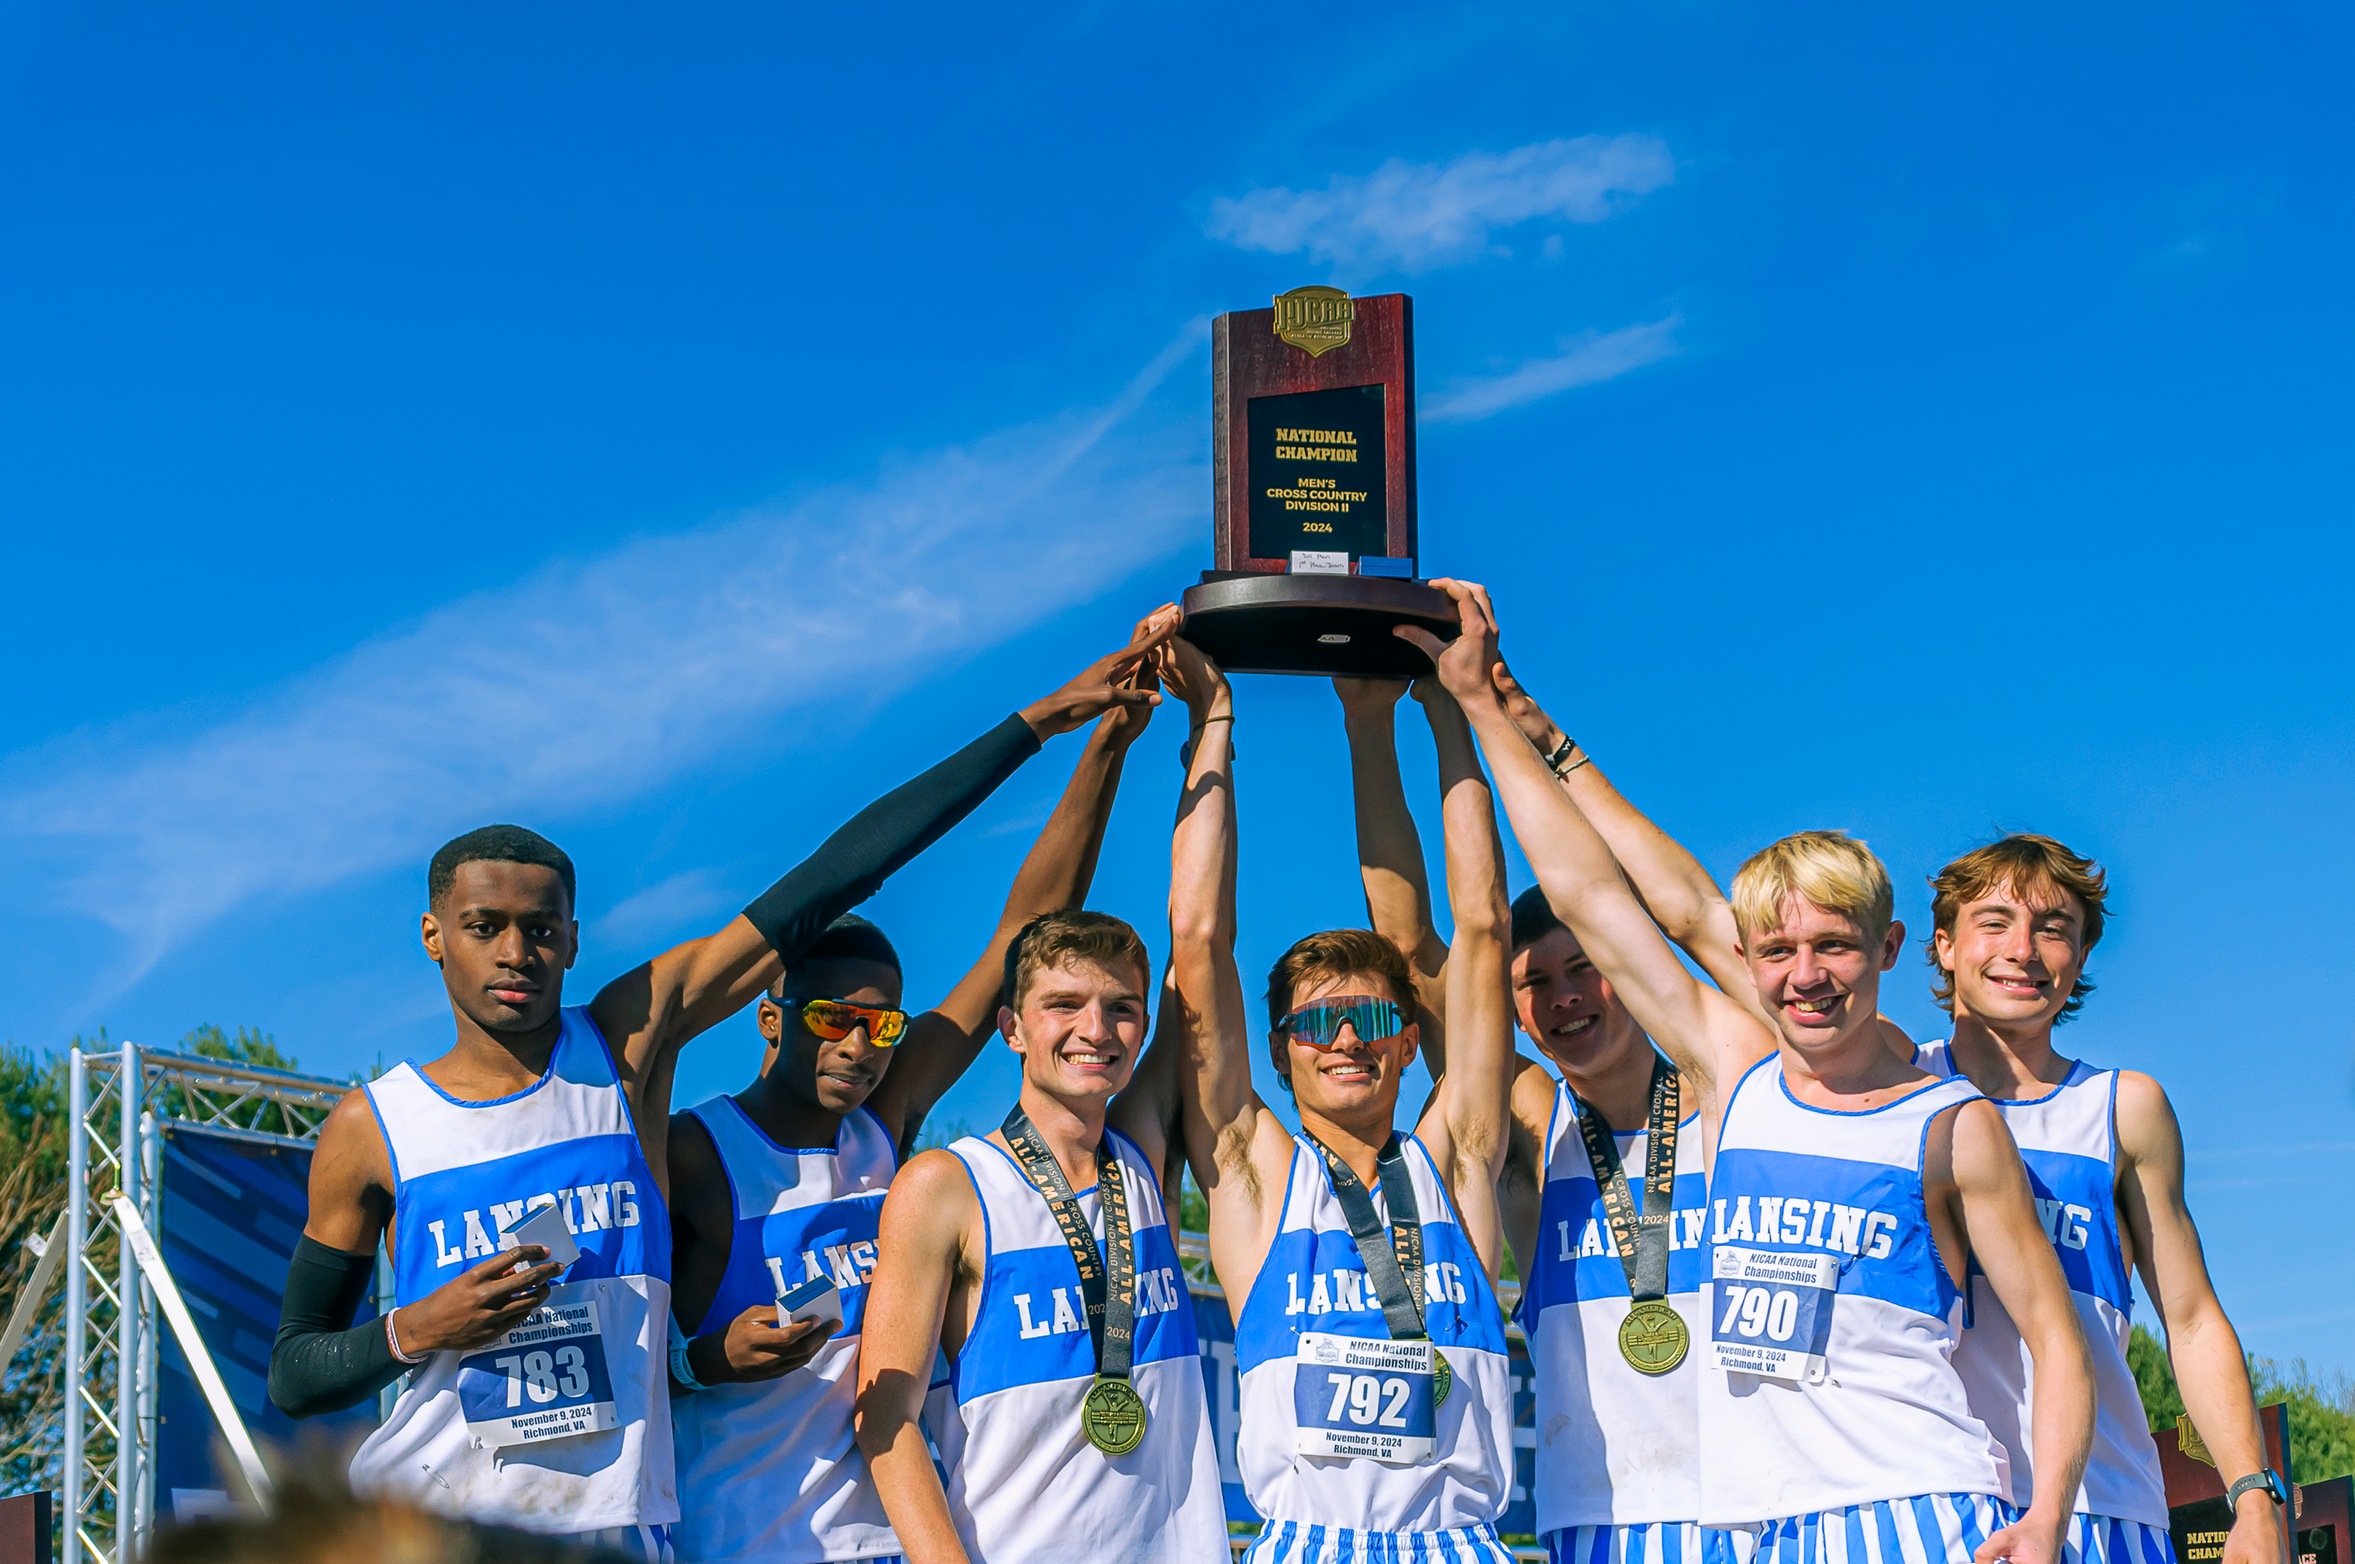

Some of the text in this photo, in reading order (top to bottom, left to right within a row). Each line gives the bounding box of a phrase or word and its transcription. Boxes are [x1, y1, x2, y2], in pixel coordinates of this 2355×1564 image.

[1276, 428, 1357, 445] NATIONAL
[1276, 446, 1357, 462] CHAMPION
[1298, 478, 1336, 488] MEN'S
[1266, 488, 1367, 502] CROSS COUNTRY
[1285, 500, 1349, 512] DIVISION II
[1302, 522, 1333, 533] 2024
[1653, 1089, 1663, 1115] CROSS
[1649, 1125, 1661, 1162] DIVISION
[1648, 1164, 1657, 1193] NJCAA
[1010, 1137, 1094, 1280] ALL-AMERICAN
[1024, 1129, 1102, 1277] NJCAA DIVISION II CROSS COUNTRY
[1616, 1180, 1631, 1208] CROSS
[1625, 1210, 1641, 1248] COUNTR
[1644, 1215, 1669, 1225] 2024
[1106, 1161, 1132, 1305] ALL-AMERICA
[1558, 1207, 1708, 1262] LAIN
[1711, 1196, 1898, 1260] LANSING
[1104, 1182, 1118, 1301] NJCAA DIVISION II CROSS
[1411, 1227, 1419, 1258] NJCAA
[765, 1239, 879, 1300] LANS
[1749, 1253, 1818, 1269] NJCAA National
[1412, 1258, 1422, 1301] DIVISION
[1744, 1265, 1817, 1283] Championships
[1285, 1262, 1467, 1316] LANSNG
[1013, 1267, 1179, 1340] LANG
[1088, 1303, 1105, 1315] 202
[545, 1306, 589, 1323] National
[1718, 1285, 1799, 1342] 790
[508, 1322, 594, 1344] Championships
[1106, 1326, 1131, 1340] 2024
[1349, 1341, 1426, 1357] NJCAA National
[1715, 1344, 1787, 1362] November 9, 2024
[1345, 1353, 1427, 1371] Championships
[1720, 1356, 1776, 1373] Richmond, VA
[495, 1346, 590, 1408] 783
[1326, 1372, 1411, 1428] 792
[511, 1407, 592, 1429] November 9, 2024
[523, 1420, 586, 1439] Richmond, VA
[1325, 1432, 1402, 1447] November 9, 2024
[1333, 1445, 1392, 1458] Richmond, VA
[2187, 1531, 2229, 1545] NATIO
[2188, 1547, 2224, 1560] CHAM
